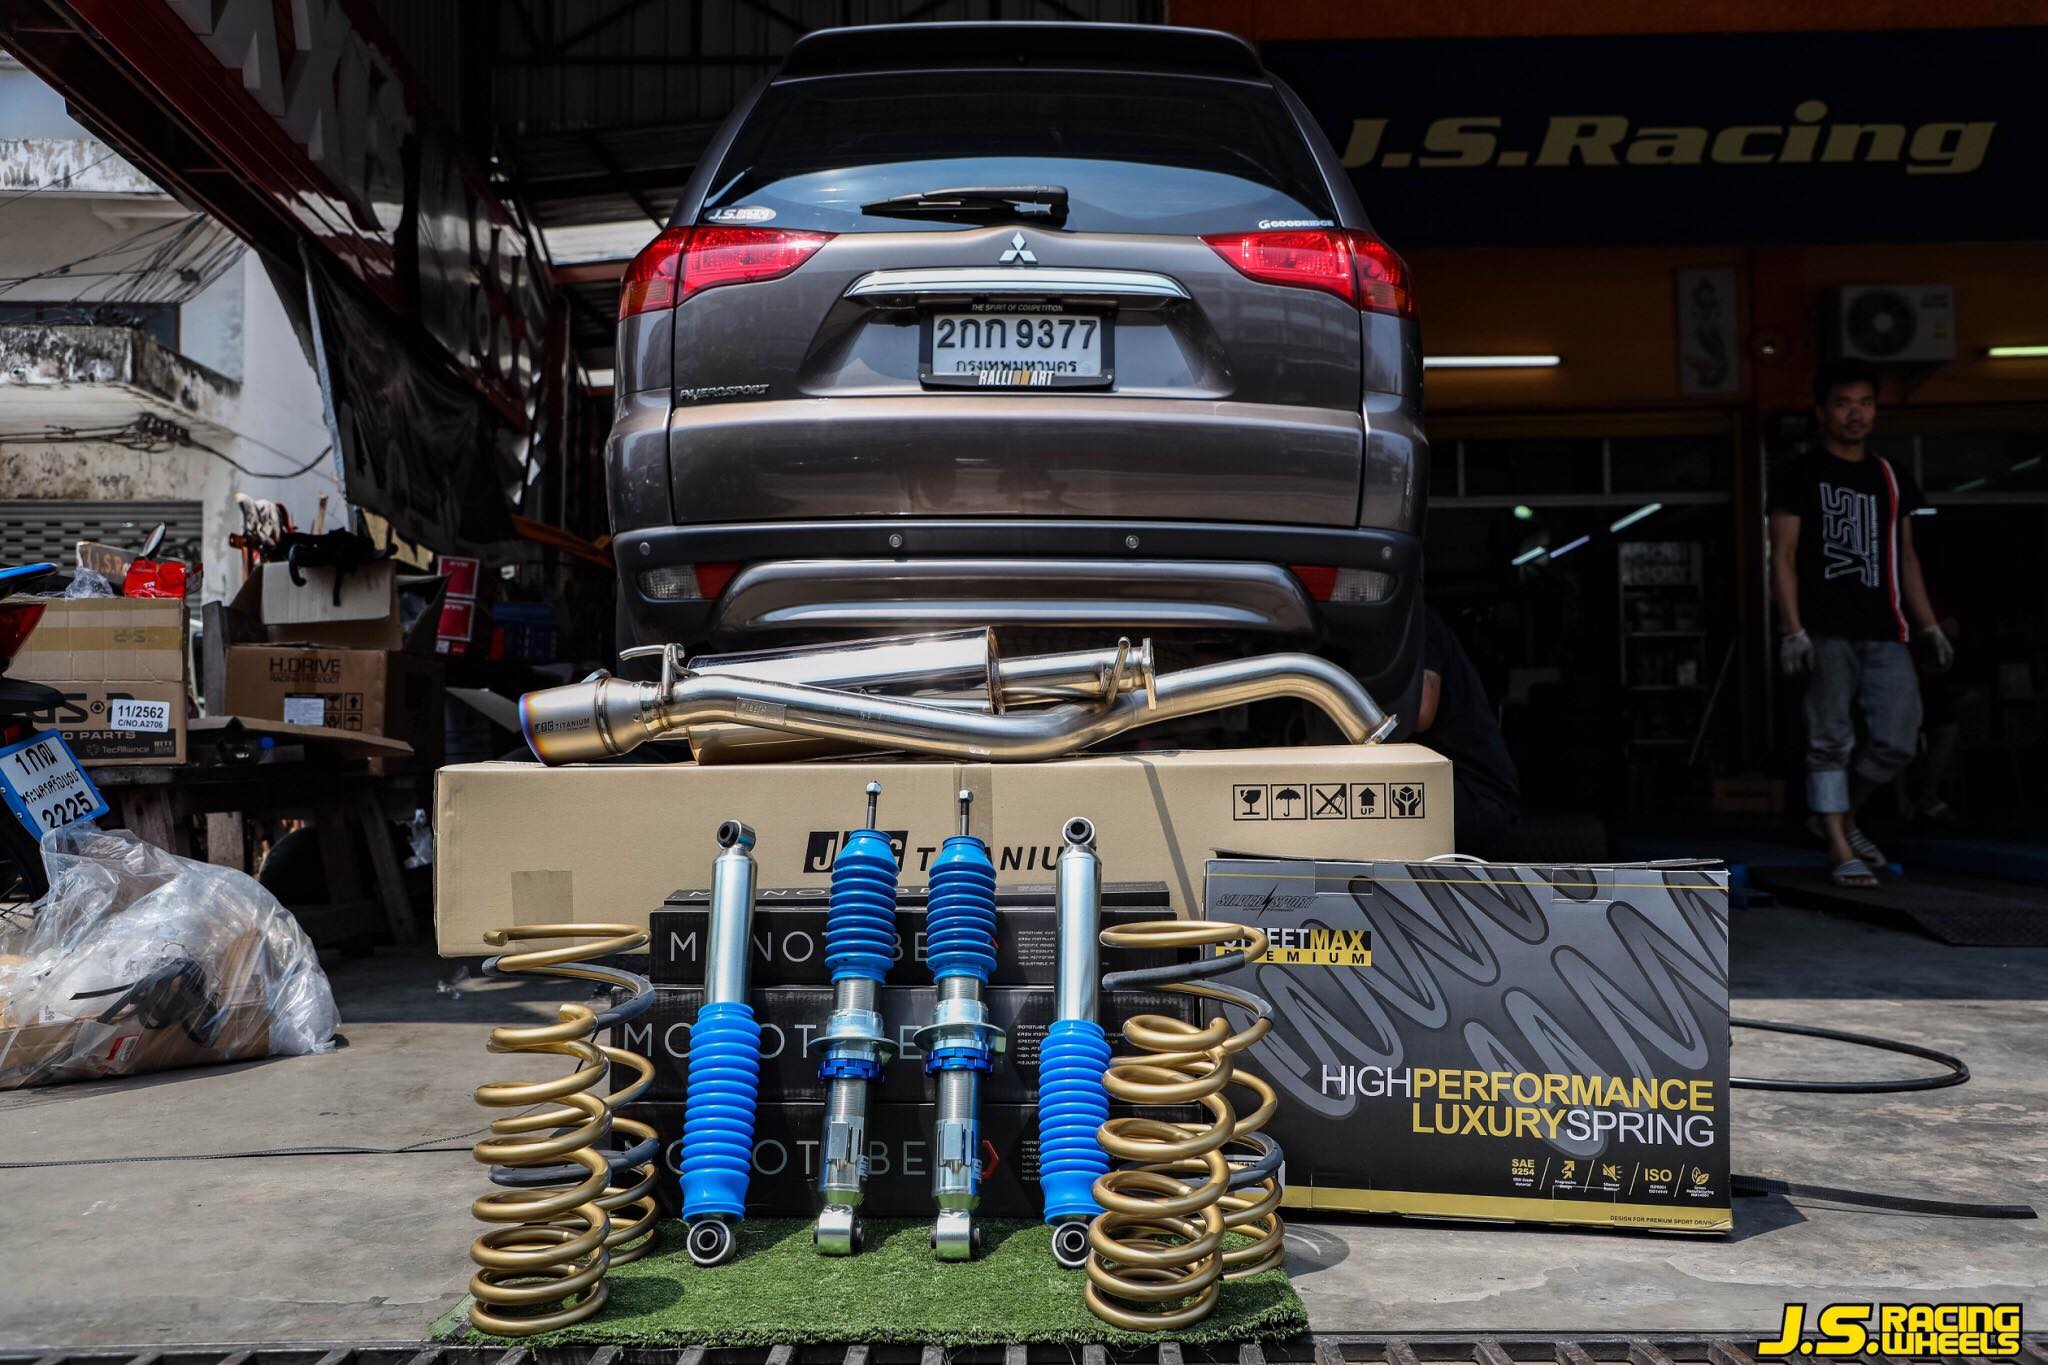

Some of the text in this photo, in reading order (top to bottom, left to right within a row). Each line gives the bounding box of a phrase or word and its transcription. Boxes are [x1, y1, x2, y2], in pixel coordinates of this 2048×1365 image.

[1344, 100, 1998, 175] J.S.Racing
[971, 303, 1063, 313] THE SPIRIT OF COMPETITION
[936, 318, 1098, 350] 2กก 9377
[269, 657, 342, 674] H.DRIVE
[118, 705, 165, 719] 11/2562
[117, 719, 164, 729] C/NO.A2706
[79, 731, 137, 740] PARTS
[42, 790, 94, 829] 2225
[1360, 807, 1375, 816] UP
[1511, 1158, 1536, 1168] SAE
[1511, 1168, 1536, 1177] 9254
[1644, 1168, 1673, 1182] ISO
